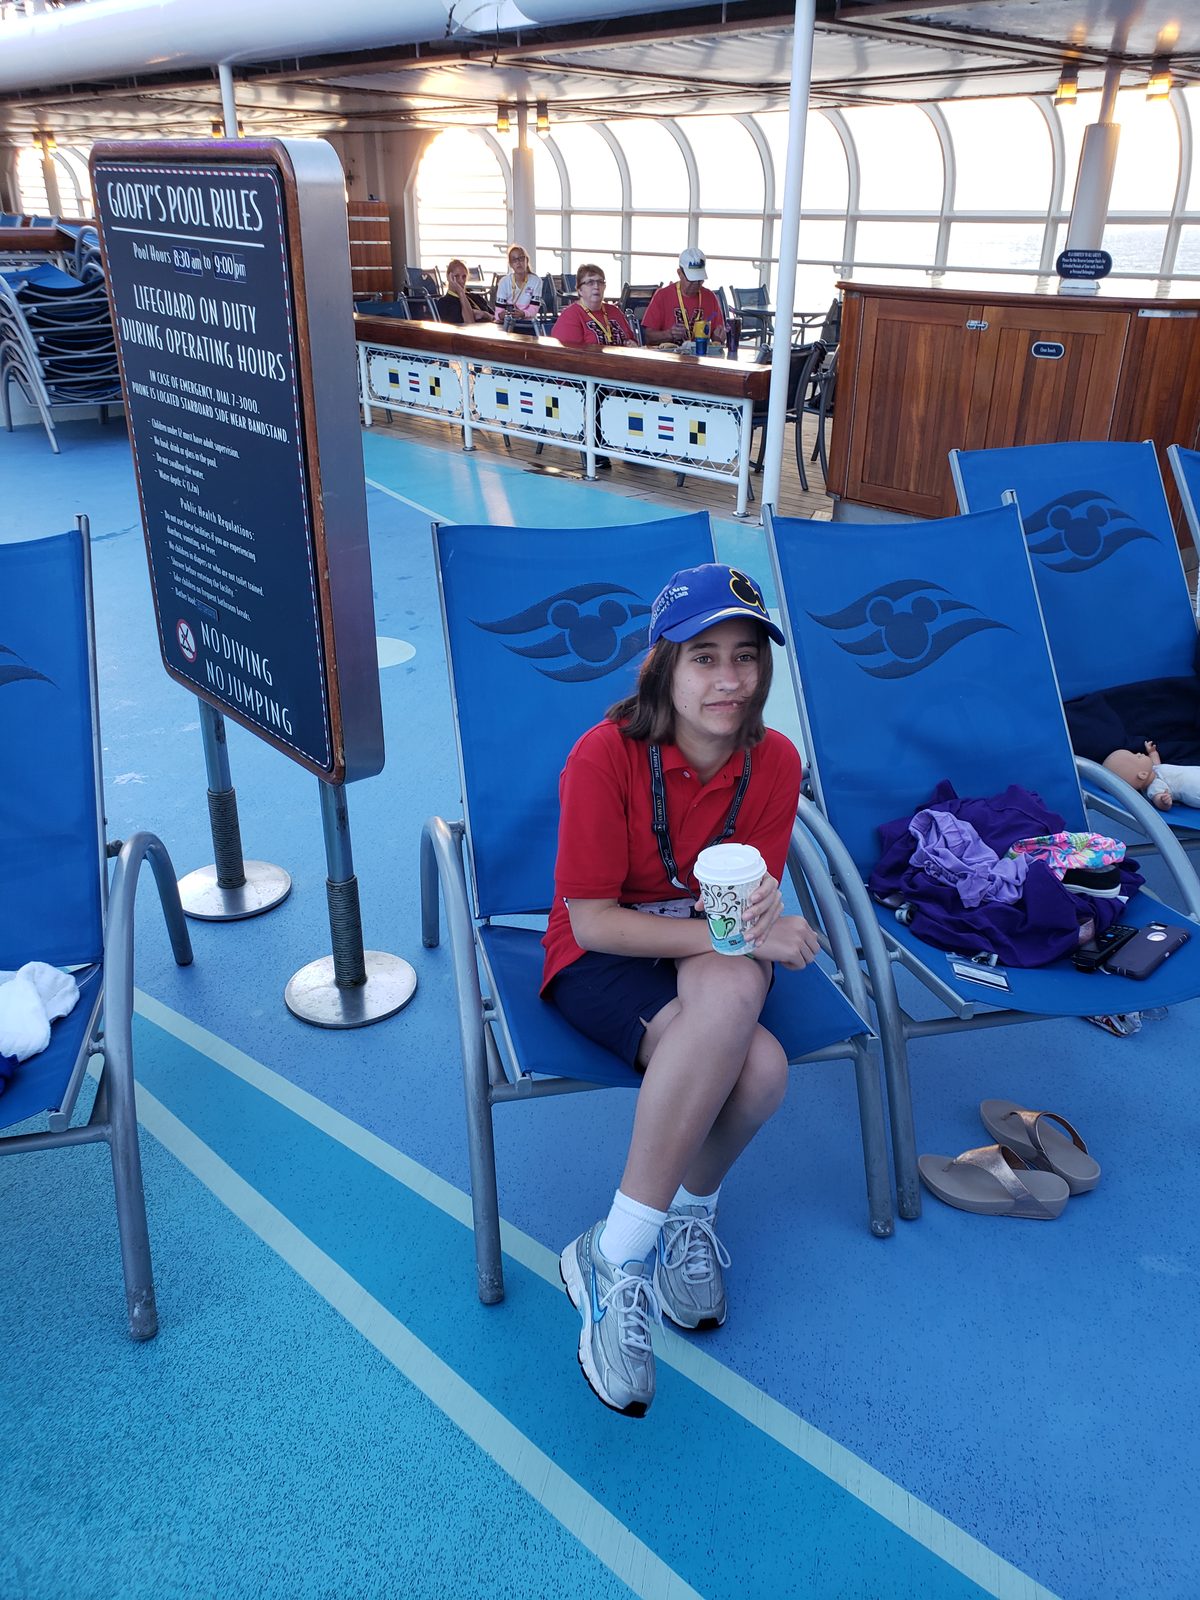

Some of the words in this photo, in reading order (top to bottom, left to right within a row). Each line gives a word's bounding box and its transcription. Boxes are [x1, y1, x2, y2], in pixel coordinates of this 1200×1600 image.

[108, 182, 166, 222] GOOFY'S
[167, 186, 210, 226] POOL
[210, 188, 262, 231] RULES
[133, 242, 149, 260] Pool
[150, 245, 171, 263] Hours
[203, 255, 211, 269] to
[134, 284, 195, 320] LIFEGUARD
[200, 297, 218, 326] ON
[222, 301, 255, 334] DUTY
[121, 317, 163, 350] DURING
[166, 328, 233, 368] OPERATING
[237, 344, 285, 381] HOURS
[132, 382, 149, 397] PHONE
[150, 387, 156, 399] IS
[157, 390, 179, 407] LOCATED
[180, 397, 213, 418] STARBOARD
[215, 408, 229, 424] SIDE
[230, 413, 246, 429] NEAR
[150, 370, 156, 382] IN
[157, 372, 170, 387] CASE
[171, 376, 178, 389] OF
[216, 390, 230, 405] DIAL
[180, 498, 197, 514] Public
[198, 506, 216, 523] Health
[218, 514, 254, 541] Regulations:
[201, 621, 220, 653] NO
[222, 634, 272, 686] DIVING
[206, 659, 224, 690] NO
[228, 673, 292, 735] JUMPING
